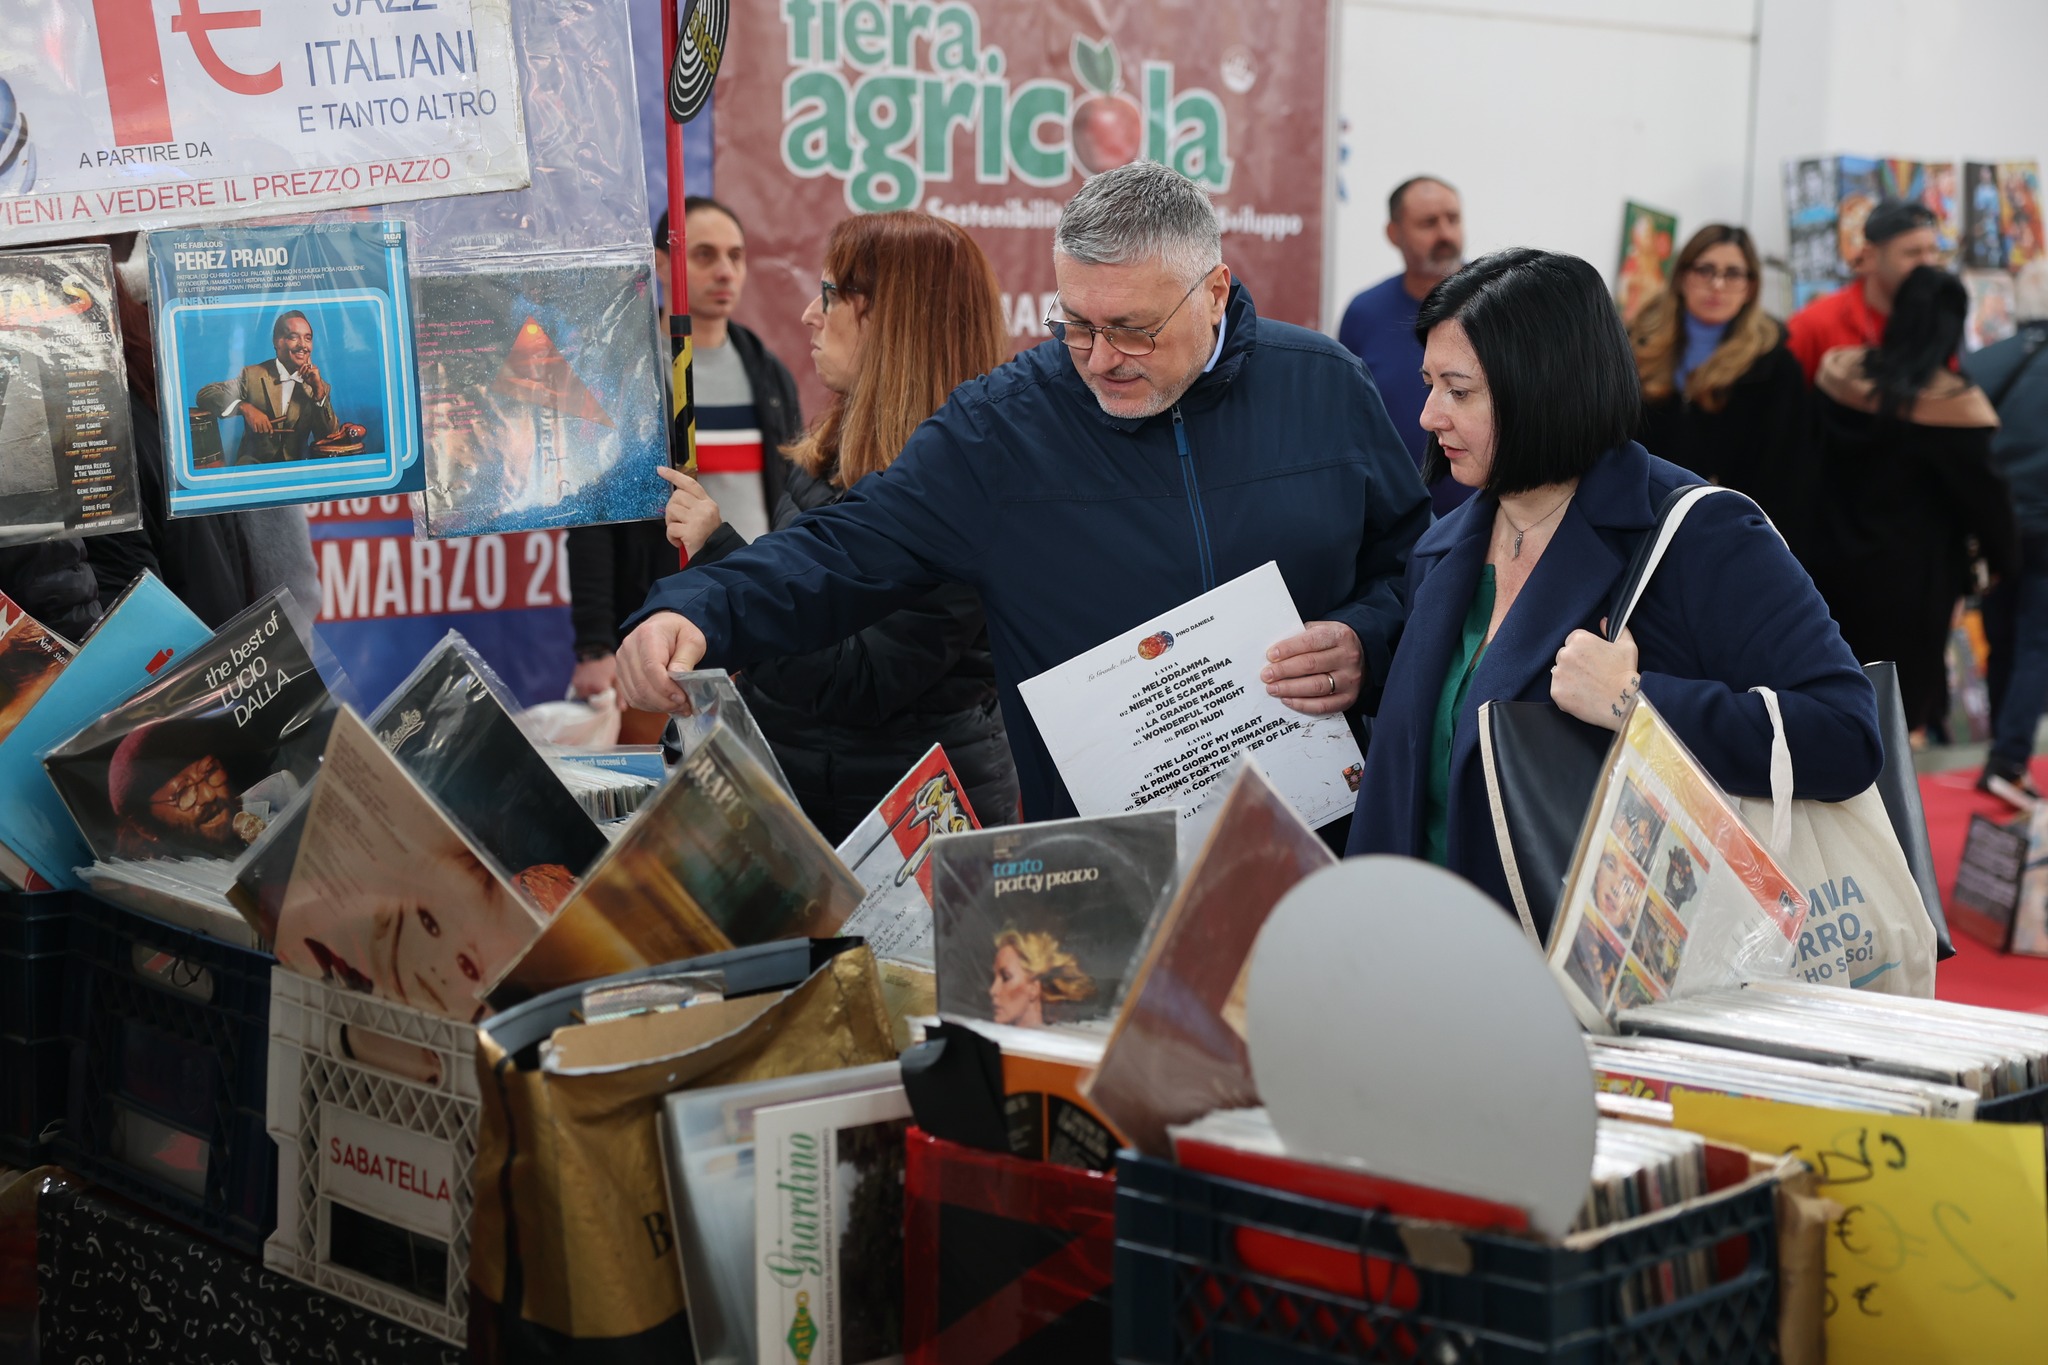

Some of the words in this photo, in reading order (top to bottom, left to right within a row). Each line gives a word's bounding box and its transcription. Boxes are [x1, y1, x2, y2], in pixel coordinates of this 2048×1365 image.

[305, 30, 477, 86] ITALIANI
[298, 105, 316, 133] E
[321, 97, 409, 130] TANTO
[416, 89, 497, 122] ALTRO
[79, 152, 93, 169] A
[97, 144, 179, 168] PARTIRE
[185, 142, 212, 158] DA
[0, 198, 63, 226] IENI
[72, 195, 92, 219] A
[96, 182, 215, 216] VEDERE
[223, 180, 246, 203] IL
[253, 167, 361, 200] PREZZO
[369, 157, 451, 186] PAZZO
[174, 249, 228, 271] PEREZ
[231, 247, 289, 268] PRADO
[189, 241, 223, 249] FABULOUS
[321, 534, 507, 621] MARZO
[36, 635, 53, 653] Non
[205, 660, 231, 689] the
[230, 628, 266, 667] best
[264, 609, 279, 636] of
[1175, 627, 1190, 638] PINO
[1190, 615, 1215, 631] DANIELE
[220, 656, 267, 709] LUCIO
[1129, 690, 1165, 712] NIENTE
[1164, 685, 1173, 695] È
[1172, 672, 1202, 691] COME
[1201, 657, 1233, 677] PRIMA
[1142, 656, 1211, 694] MELODRAMMA
[1154, 664, 1173, 676] LATO
[1155, 696, 1176, 712] DUE
[1176, 677, 1215, 701] SCARPE
[234, 668, 291, 728] DALLA
[1142, 708, 1204, 742] WONDERFUL
[1203, 686, 1246, 711] TONIGHT
[1144, 717, 1159, 728] LA
[1159, 697, 1200, 720] GRANDE
[1200, 679, 1235, 701] MADRE
[1153, 760, 1174, 774] THE
[1173, 747, 1199, 766] LADY
[1200, 739, 1215, 751] OF
[1215, 731, 1231, 745] MY
[1230, 715, 1263, 737] HEART
[1174, 721, 1200, 739] PIEDI
[1199, 709, 1225, 726] NUDI
[1134, 775, 1190, 807] SEARCHING
[1189, 765, 1211, 781] FOR
[1210, 755, 1232, 771] THE
[1265, 732, 1279, 744] OF
[1279, 721, 1302, 737] LIFE
[1140, 782, 1151, 793] IL
[1150, 769, 1181, 788] PRIMO
[1182, 749, 1219, 773] GIORNO
[1219, 742, 1232, 753] DI
[1231, 716, 1287, 748] PRIMAVERA
[993, 858, 1044, 878] tanto
[994, 873, 1044, 898] patty
[1046, 867, 1099, 891] pravo
[329, 1136, 452, 1204] SABATELLA
[764, 1132, 824, 1289] Giardino
